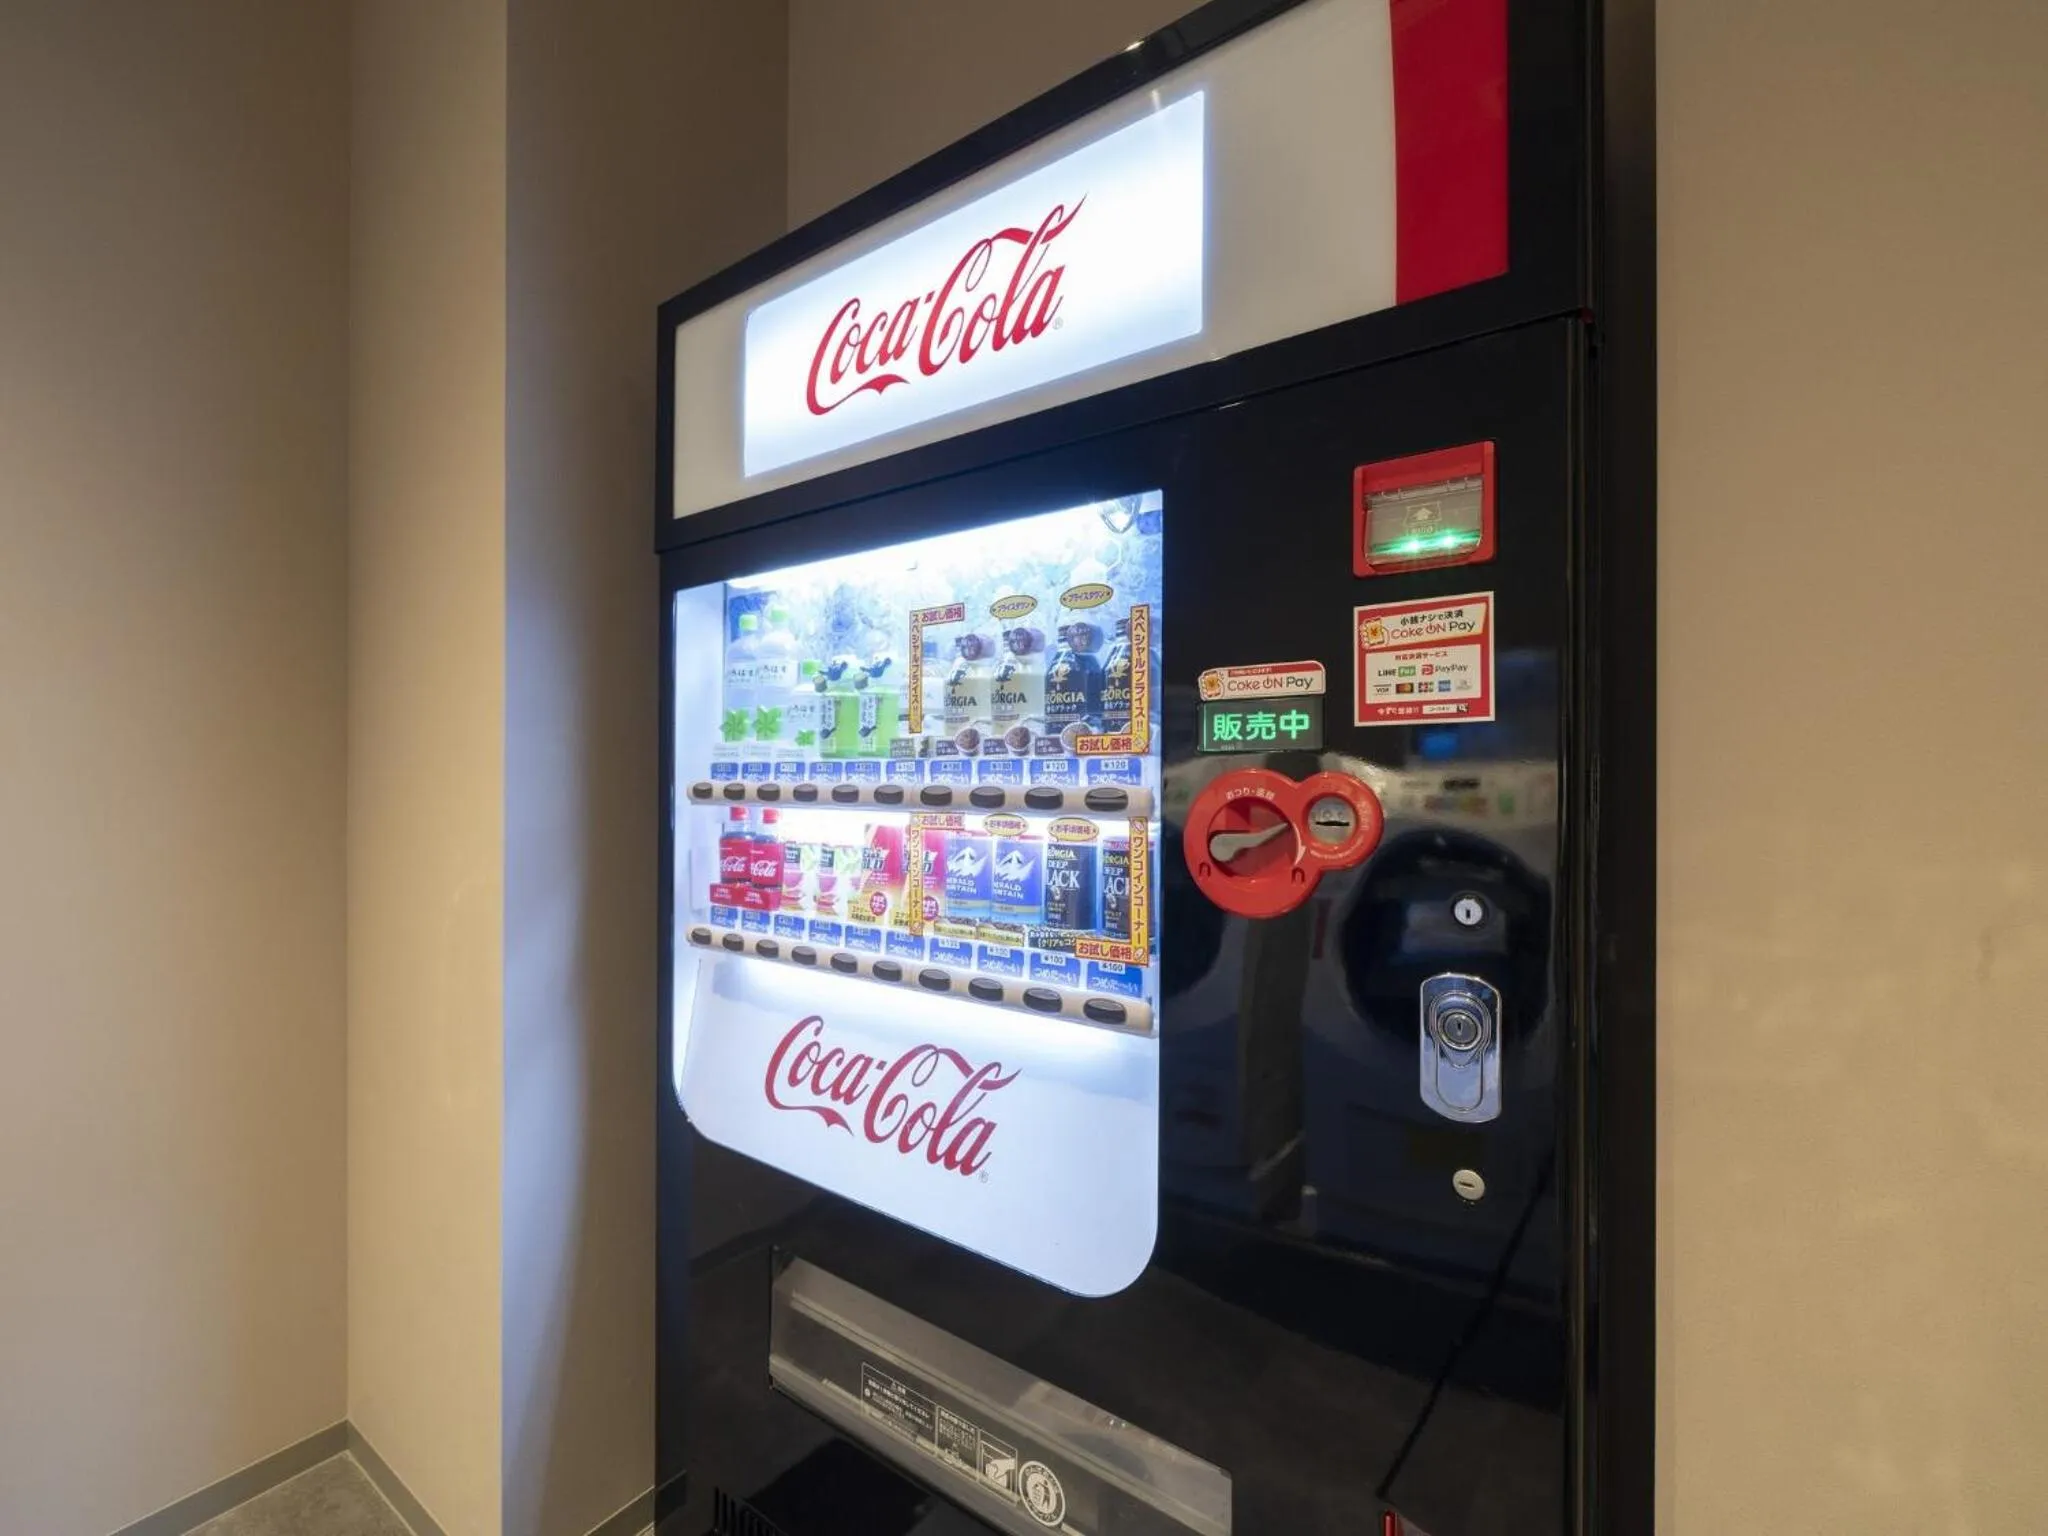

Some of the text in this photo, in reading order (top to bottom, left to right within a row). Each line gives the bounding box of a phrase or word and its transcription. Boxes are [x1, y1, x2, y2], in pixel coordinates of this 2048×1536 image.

[806, 190, 1089, 416] Coca-Cola
[921, 606, 963, 623] お試し価格
[1400, 609, 1464, 626] 小銭ナシで決済
[1390, 627, 1423, 640] Coke
[1449, 620, 1476, 633] Pay
[1434, 664, 1468, 673] PayPay
[1228, 679, 1260, 692] Coke
[1286, 675, 1314, 690] Pay
[1213, 709, 1310, 741] 販売中
[1078, 737, 1133, 752] お試し価格
[1132, 836, 1146, 944] ワンコインコーナー
[1078, 942, 1132, 960] お試し価格
[764, 1015, 1023, 1177] Coca-Cola
